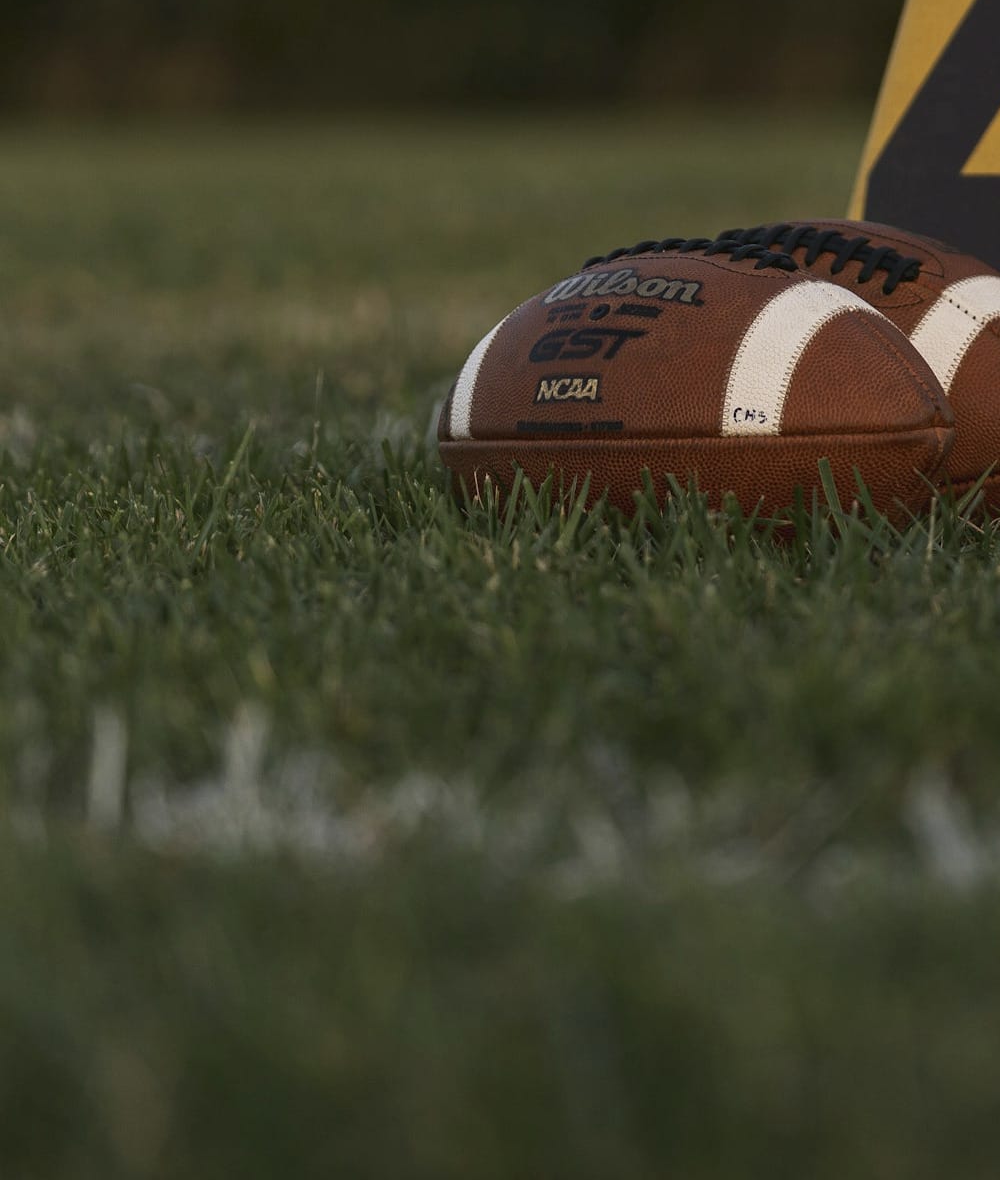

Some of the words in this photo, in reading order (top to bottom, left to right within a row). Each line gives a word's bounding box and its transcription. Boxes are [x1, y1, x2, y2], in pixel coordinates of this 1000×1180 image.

[542, 269, 703, 305] Wilson
[529, 328, 647, 362] GST
[536, 376, 600, 402] NCAA
